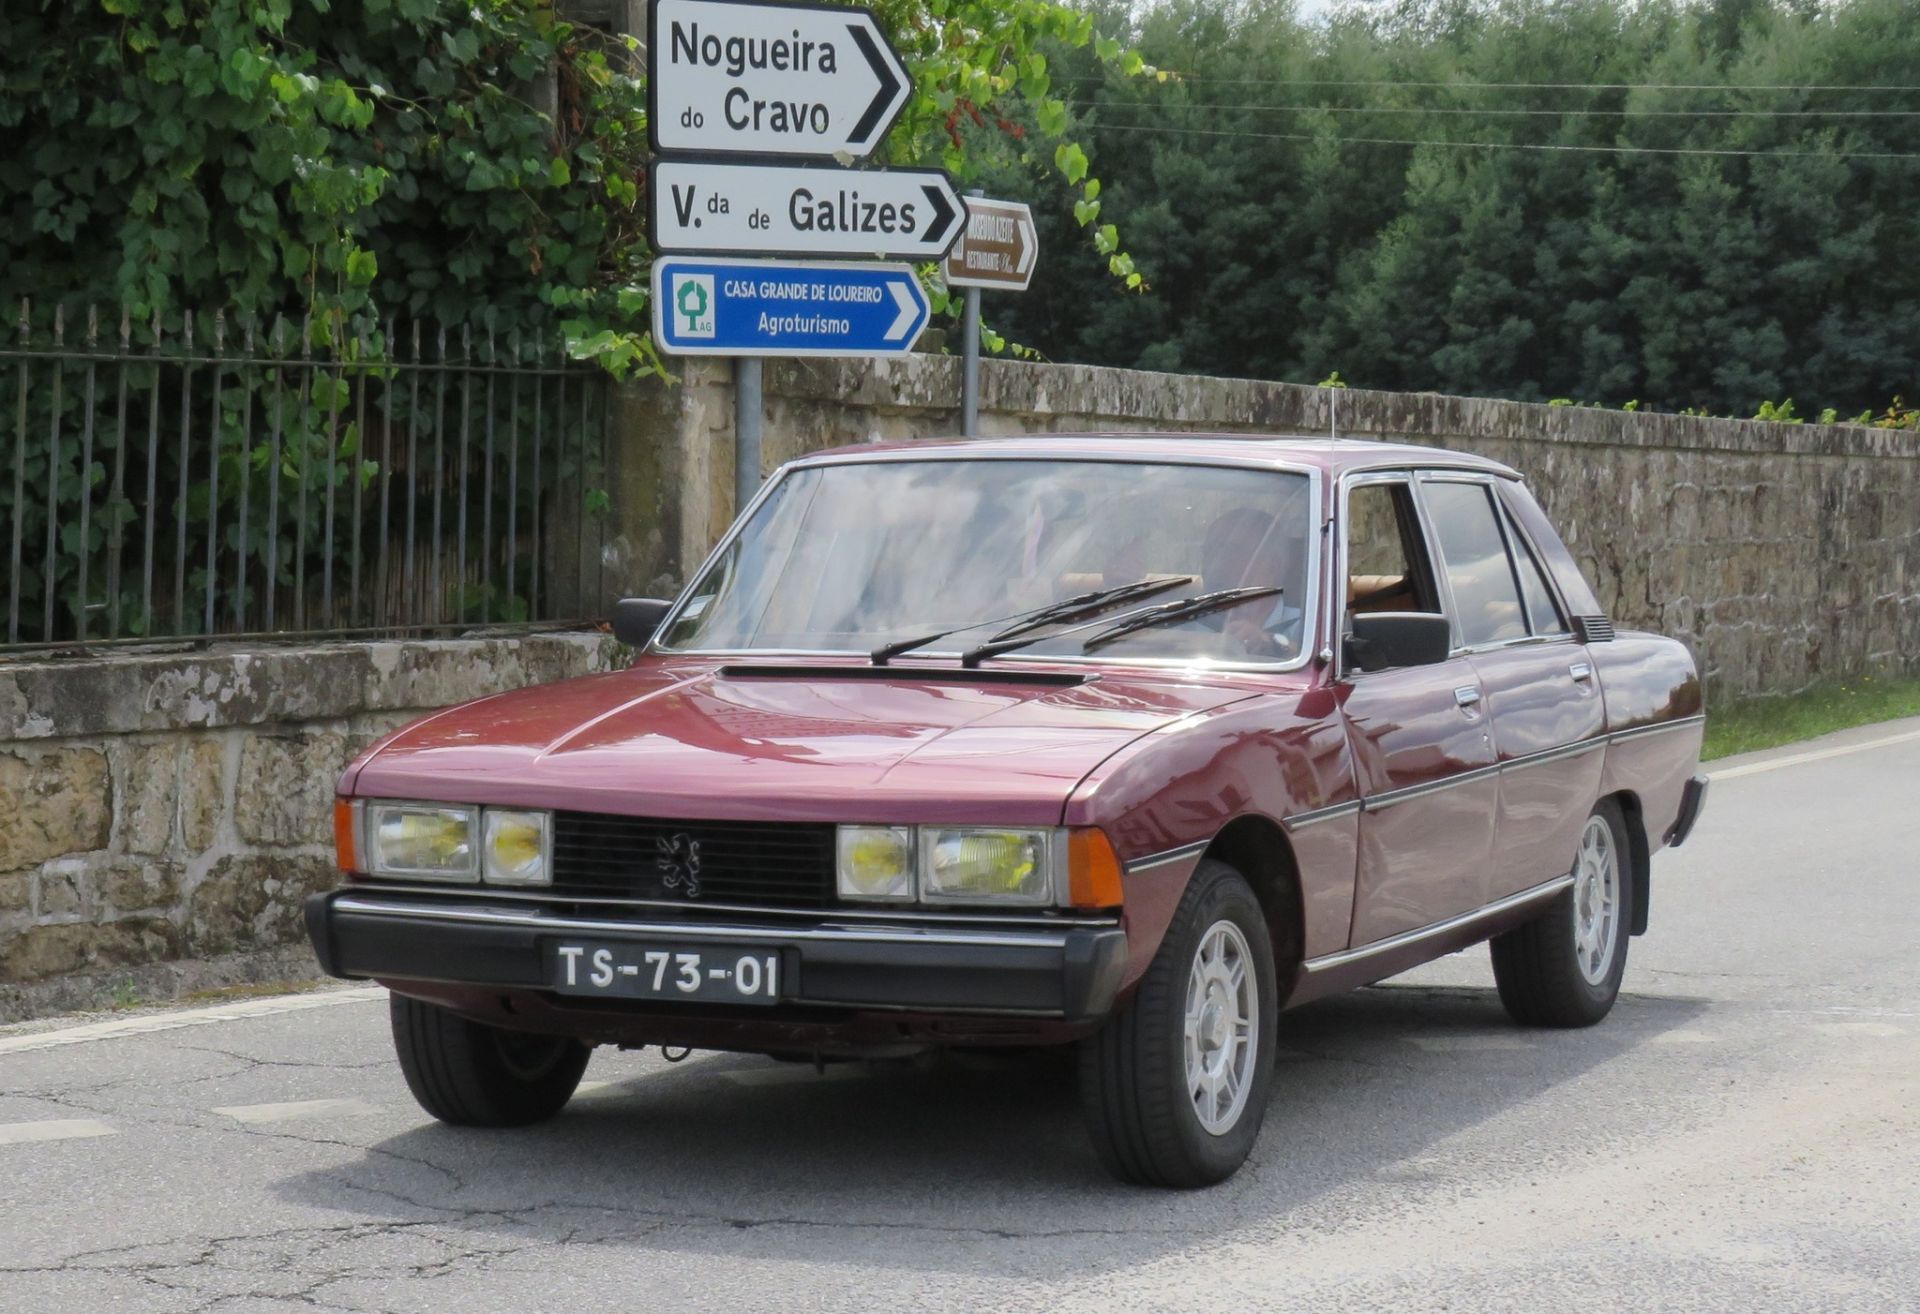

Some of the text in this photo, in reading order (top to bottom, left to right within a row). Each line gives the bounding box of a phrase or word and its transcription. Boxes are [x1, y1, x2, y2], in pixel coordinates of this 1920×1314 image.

[671, 21, 837, 77] Nogueira
[680, 86, 830, 134] do Cravo
[748, 207, 770, 230] de
[789, 188, 916, 233] Galizes
[724, 281, 882, 304] CASA GRANDE DE LOUREIRO
[699, 322, 712, 332] AG
[758, 312, 850, 336] Agroturismo
[558, 947, 776, 997] TS-73-01
